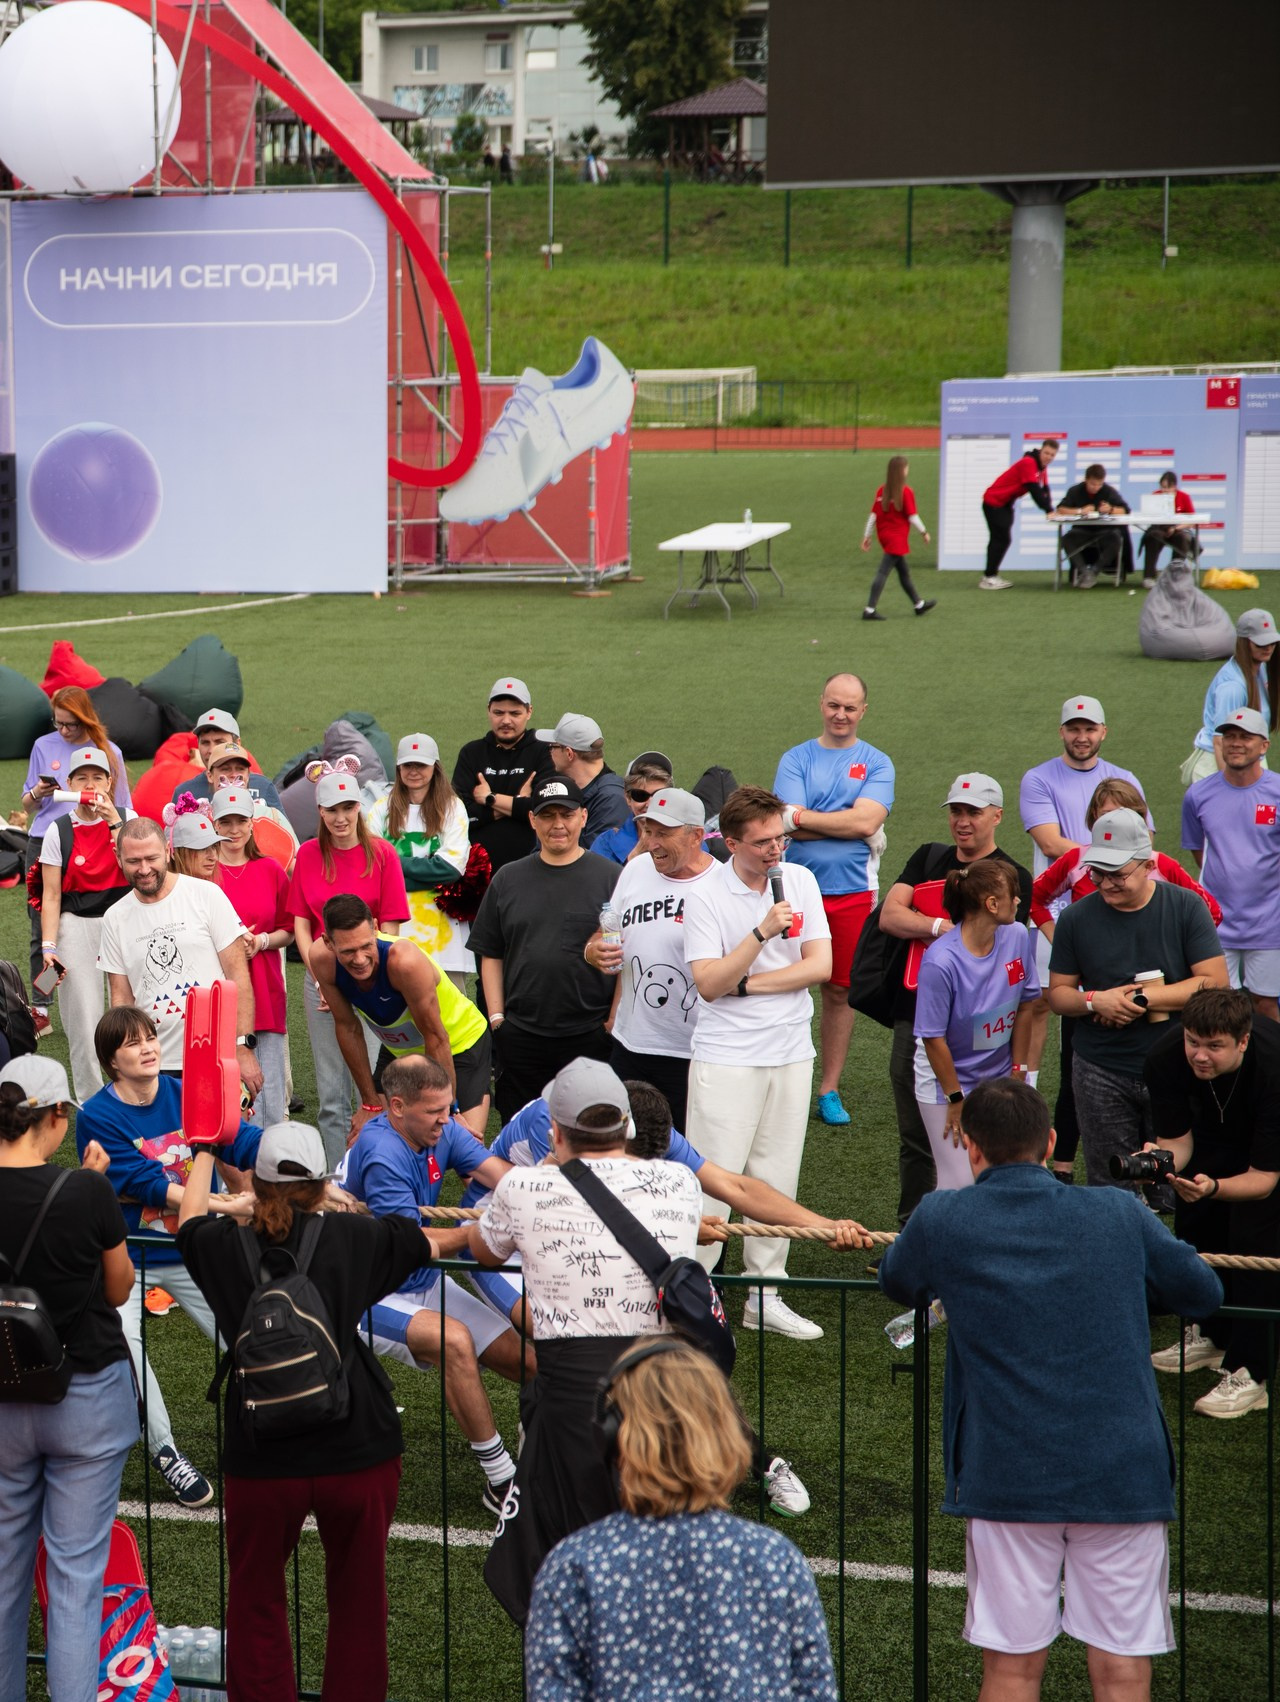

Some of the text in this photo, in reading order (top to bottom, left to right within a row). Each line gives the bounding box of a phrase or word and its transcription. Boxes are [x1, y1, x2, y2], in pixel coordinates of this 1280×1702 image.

[59, 262, 338, 291] НАЧНИ СЕГОДНЯ
[532, 1217, 606, 1237] BRUTALITY
[591, 1287, 614, 1297] LESS
[583, 1297, 606, 1309] FEAR
[617, 1298, 658, 1316] UTALITY
